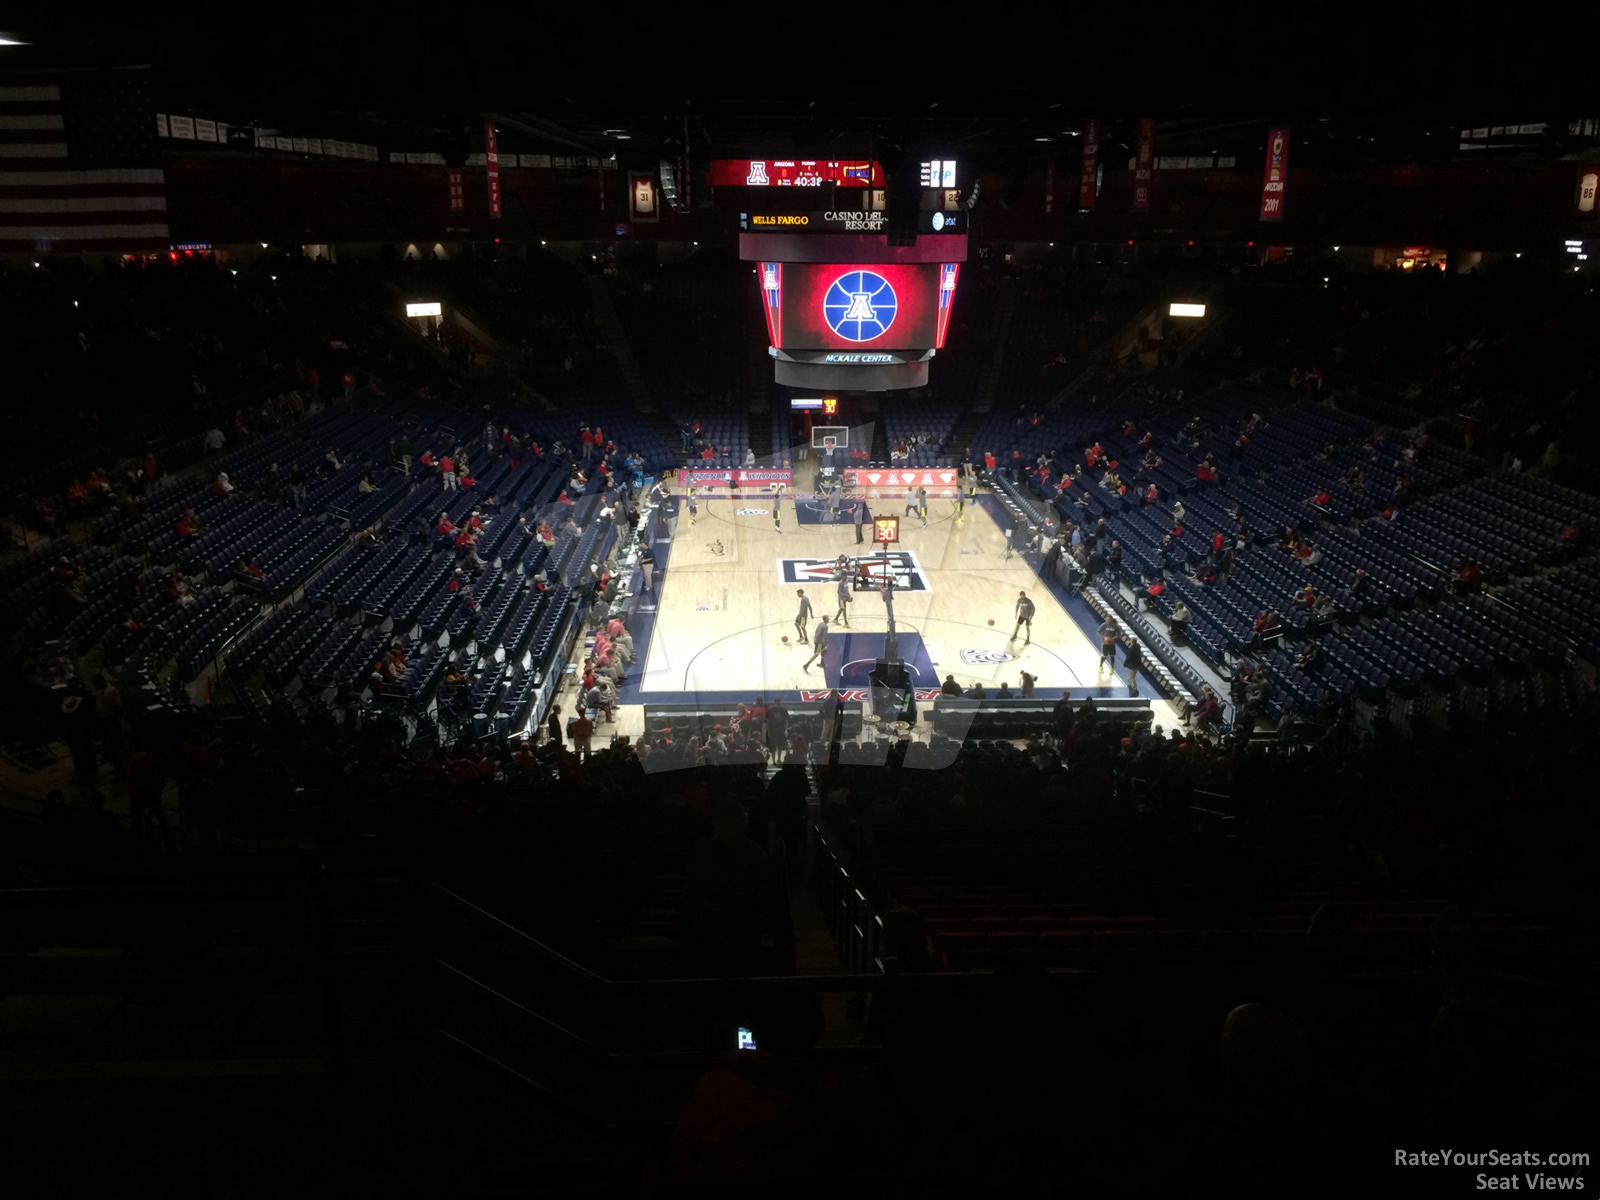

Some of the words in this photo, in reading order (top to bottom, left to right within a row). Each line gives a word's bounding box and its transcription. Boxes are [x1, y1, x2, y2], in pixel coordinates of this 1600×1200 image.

[641, 193, 649, 201] 31
[1583, 188, 1594, 199] 86
[1264, 199, 1280, 212] 2001
[752, 216, 776, 225] WELLS
[777, 216, 809, 225] FARGO
[824, 212, 863, 222] CASINO
[845, 221, 883, 231] RESORT
[843, 292, 877, 321] A
[861, 355, 893, 363] CENTER
[879, 528, 894, 540] 30
